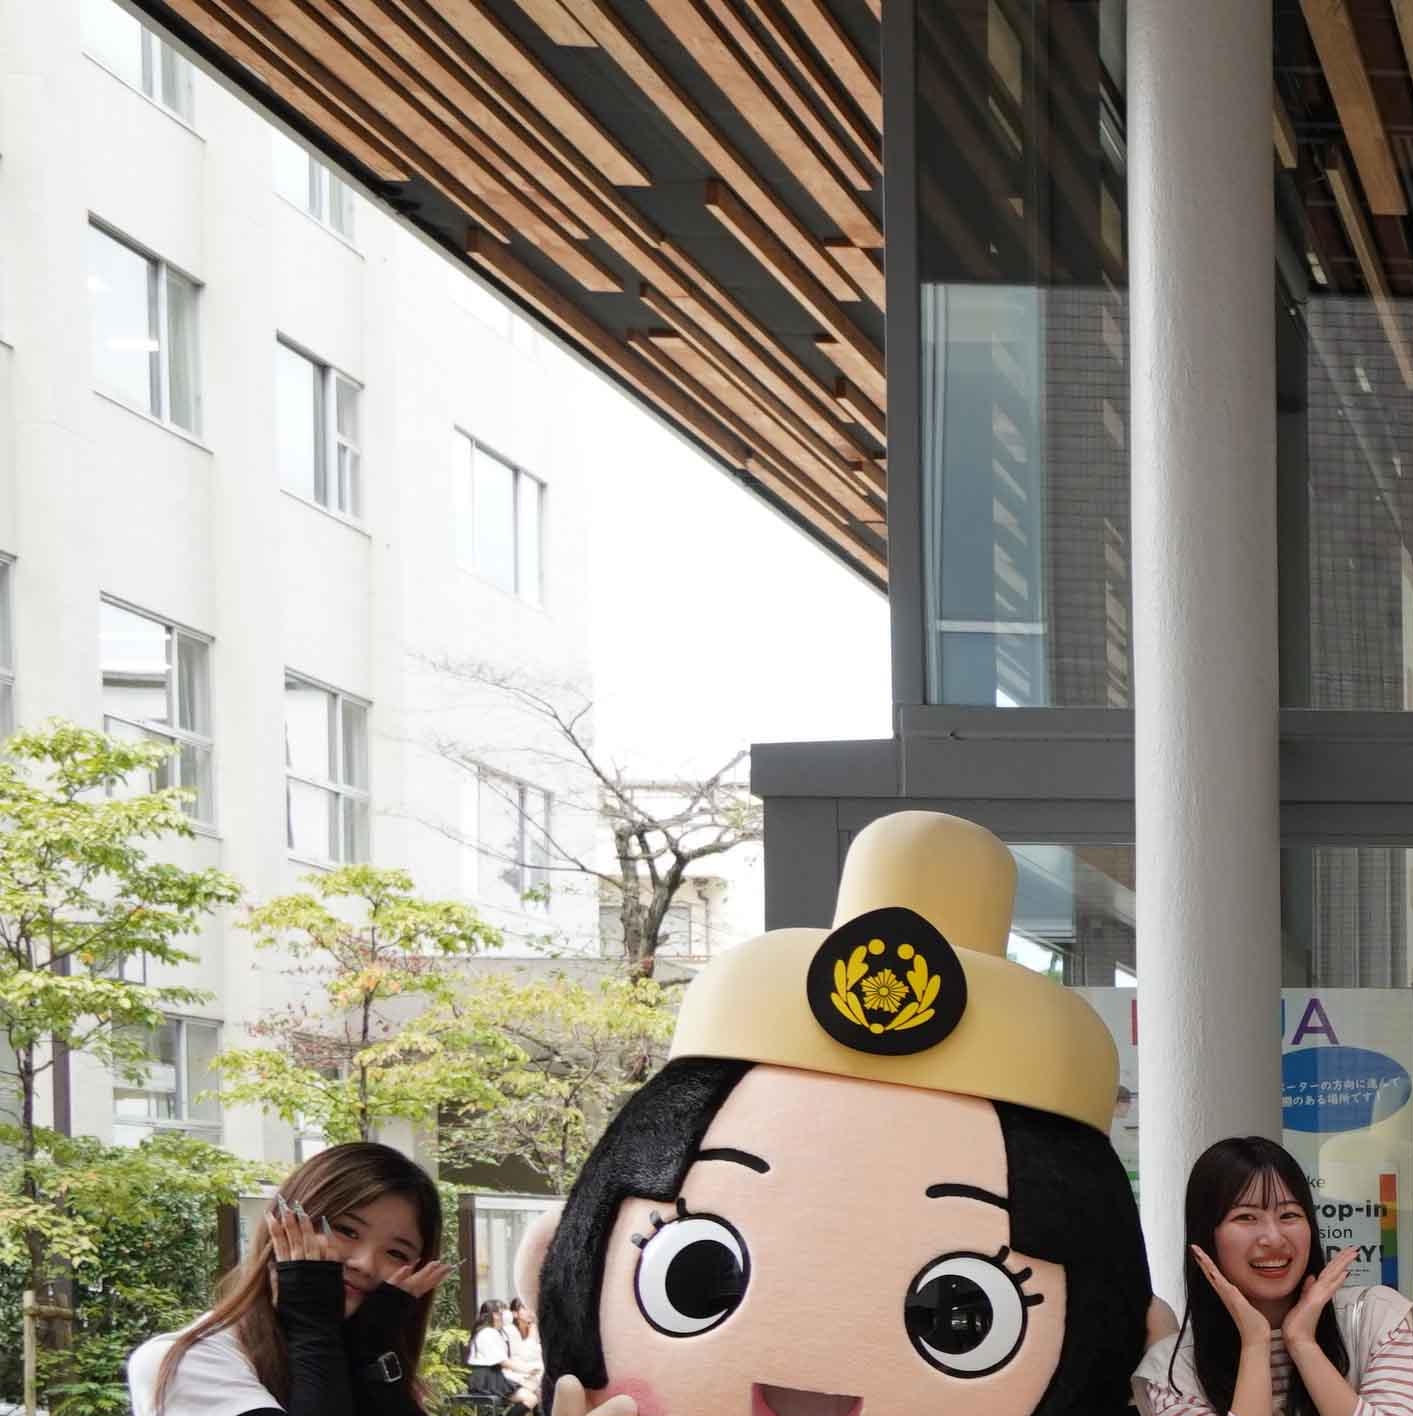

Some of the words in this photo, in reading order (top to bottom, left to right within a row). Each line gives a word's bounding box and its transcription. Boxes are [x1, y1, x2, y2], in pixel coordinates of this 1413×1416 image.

[1307, 1175, 1326, 1189] ke
[1313, 1199, 1388, 1221] rop-in
[1319, 1225, 1353, 1239] sion
